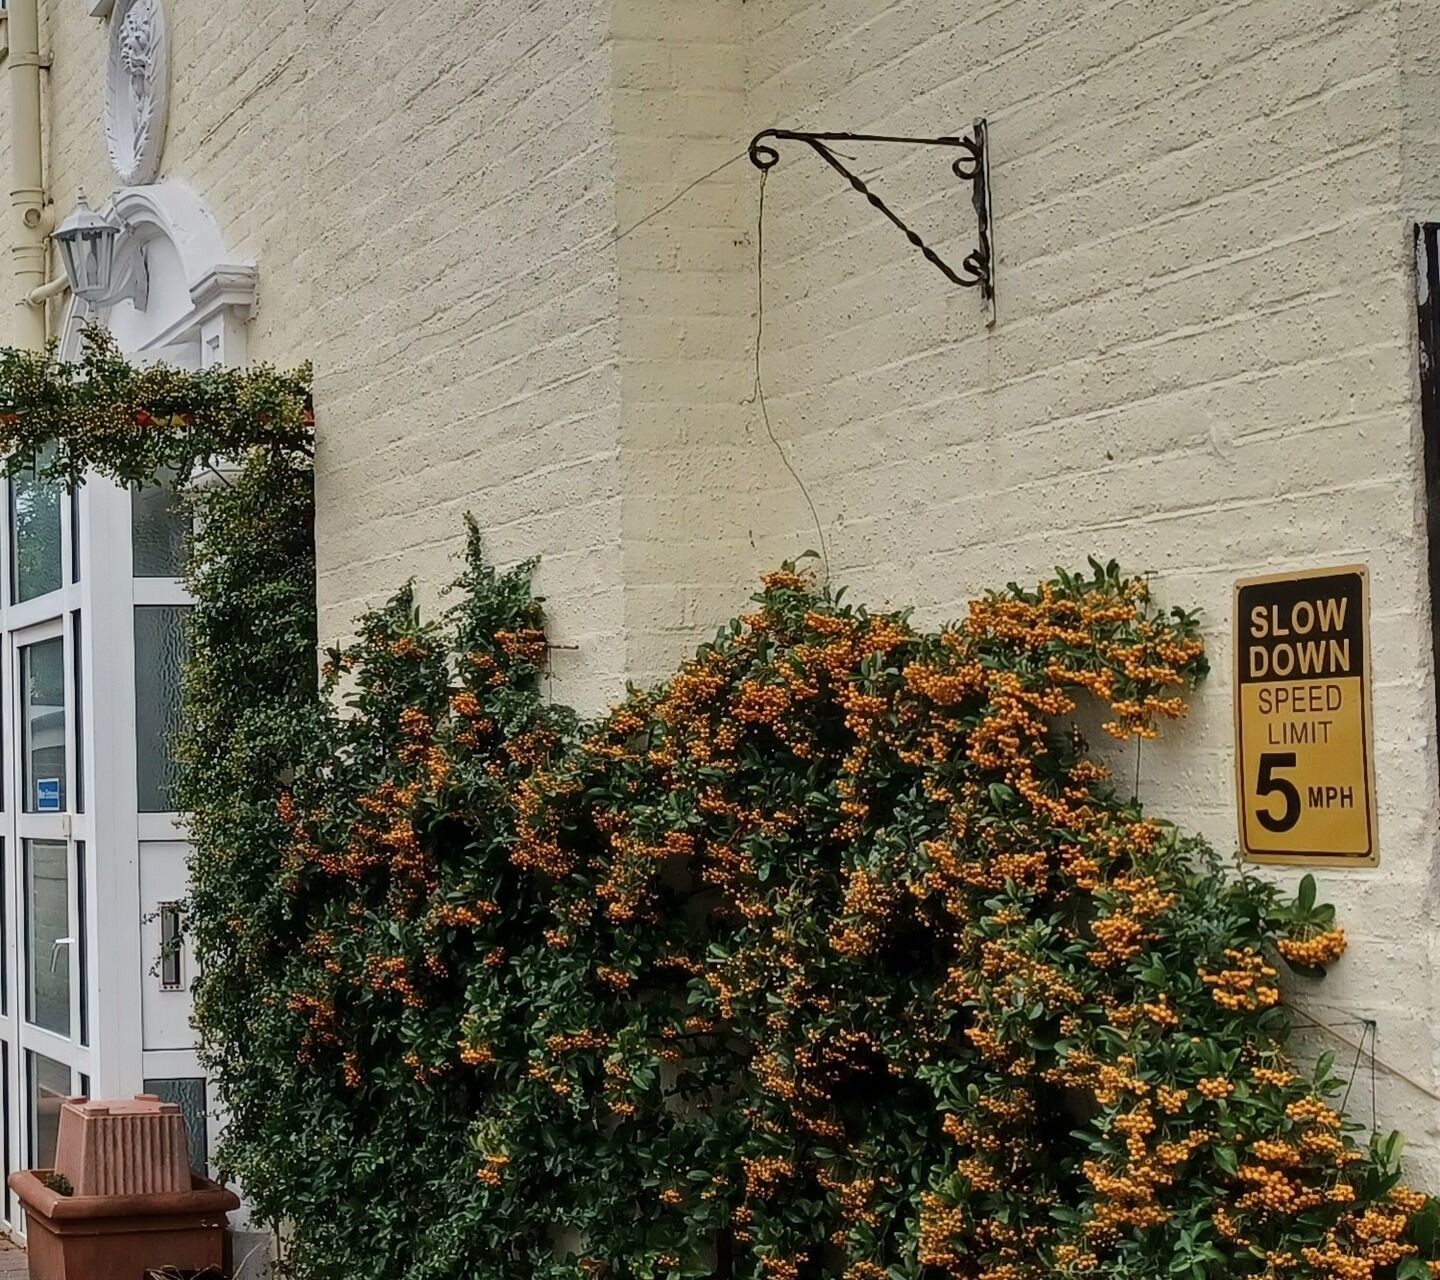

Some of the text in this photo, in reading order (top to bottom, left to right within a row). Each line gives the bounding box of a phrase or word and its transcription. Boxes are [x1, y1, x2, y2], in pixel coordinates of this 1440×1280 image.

[1250, 597, 1348, 639] SLOW
[1249, 638, 1350, 678] DOWN
[1258, 684, 1342, 715] SPEED
[1268, 720, 1333, 745] LIMIT
[1255, 752, 1354, 833] 5 MPH
